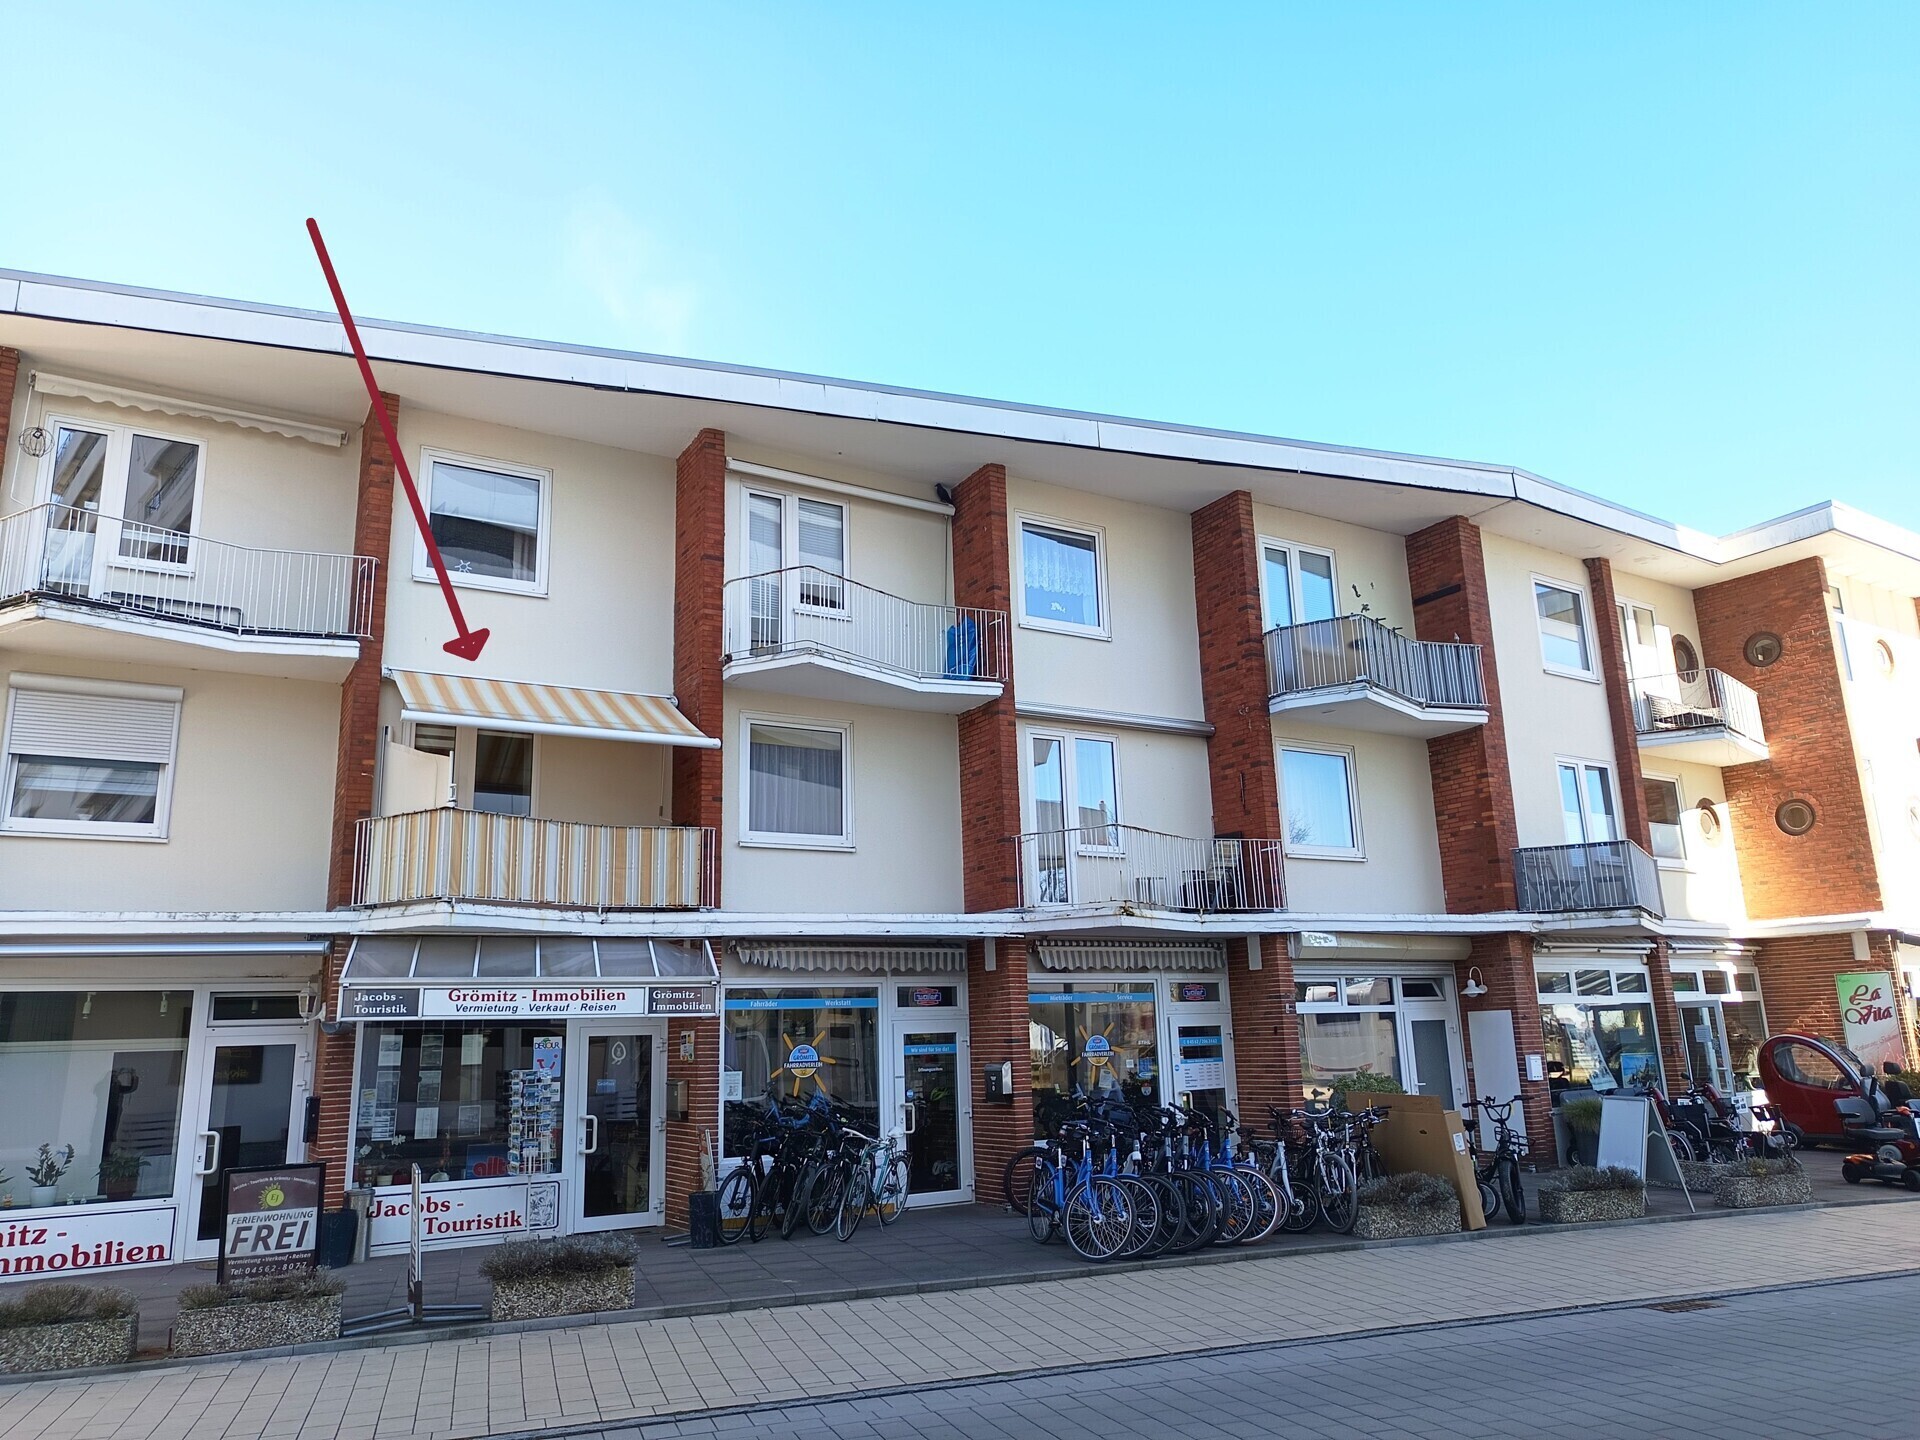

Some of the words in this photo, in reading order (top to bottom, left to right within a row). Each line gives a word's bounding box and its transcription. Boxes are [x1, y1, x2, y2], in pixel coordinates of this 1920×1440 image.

[354, 992, 397, 1002] Jacobs
[448, 988, 518, 1002] Grömitz
[532, 988, 626, 1002] Immobilien
[652, 990, 695, 999] Grömitz
[1849, 984, 1882, 1006] La
[353, 1004, 408, 1014] Touristik
[455, 1003, 519, 1014] Vermietung
[528, 1003, 571, 1012] Verkauf
[580, 1002, 617, 1012] Reisen
[652, 1001, 712, 1011] Immobilien
[825, 999, 852, 1007] Werkstatt
[1844, 1004, 1893, 1026] Vita
[371, 1196, 451, 1219] Jacbs
[231, 1210, 314, 1225] FERIENWOHNUNG
[423, 1209, 523, 1235] Touristik
[229, 1220, 310, 1255] FREI
[227, 1257, 262, 1266] Vermietung
[265, 1254, 289, 1263] Verkauf
[292, 1252, 312, 1260] Reisen
[230, 1267, 244, 1276] Tel:
